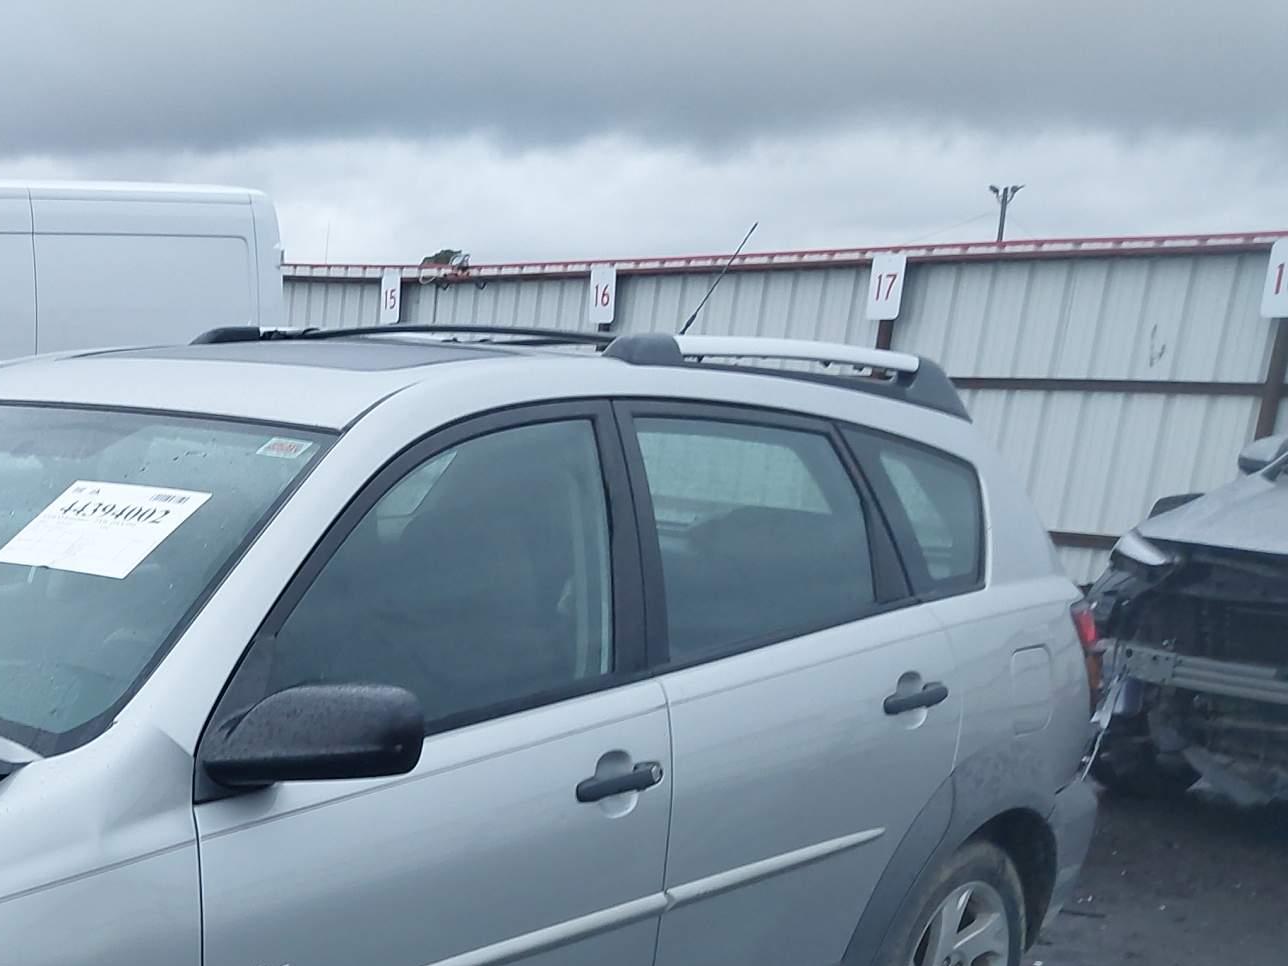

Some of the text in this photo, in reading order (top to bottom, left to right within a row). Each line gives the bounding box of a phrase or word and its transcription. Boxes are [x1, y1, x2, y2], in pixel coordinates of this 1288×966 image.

[875, 273, 898, 301] 17
[1275, 263, 1288, 295] 1
[384, 288, 397, 310] 15
[594, 284, 610, 308] 16
[59, 499, 171, 525] 44394002
